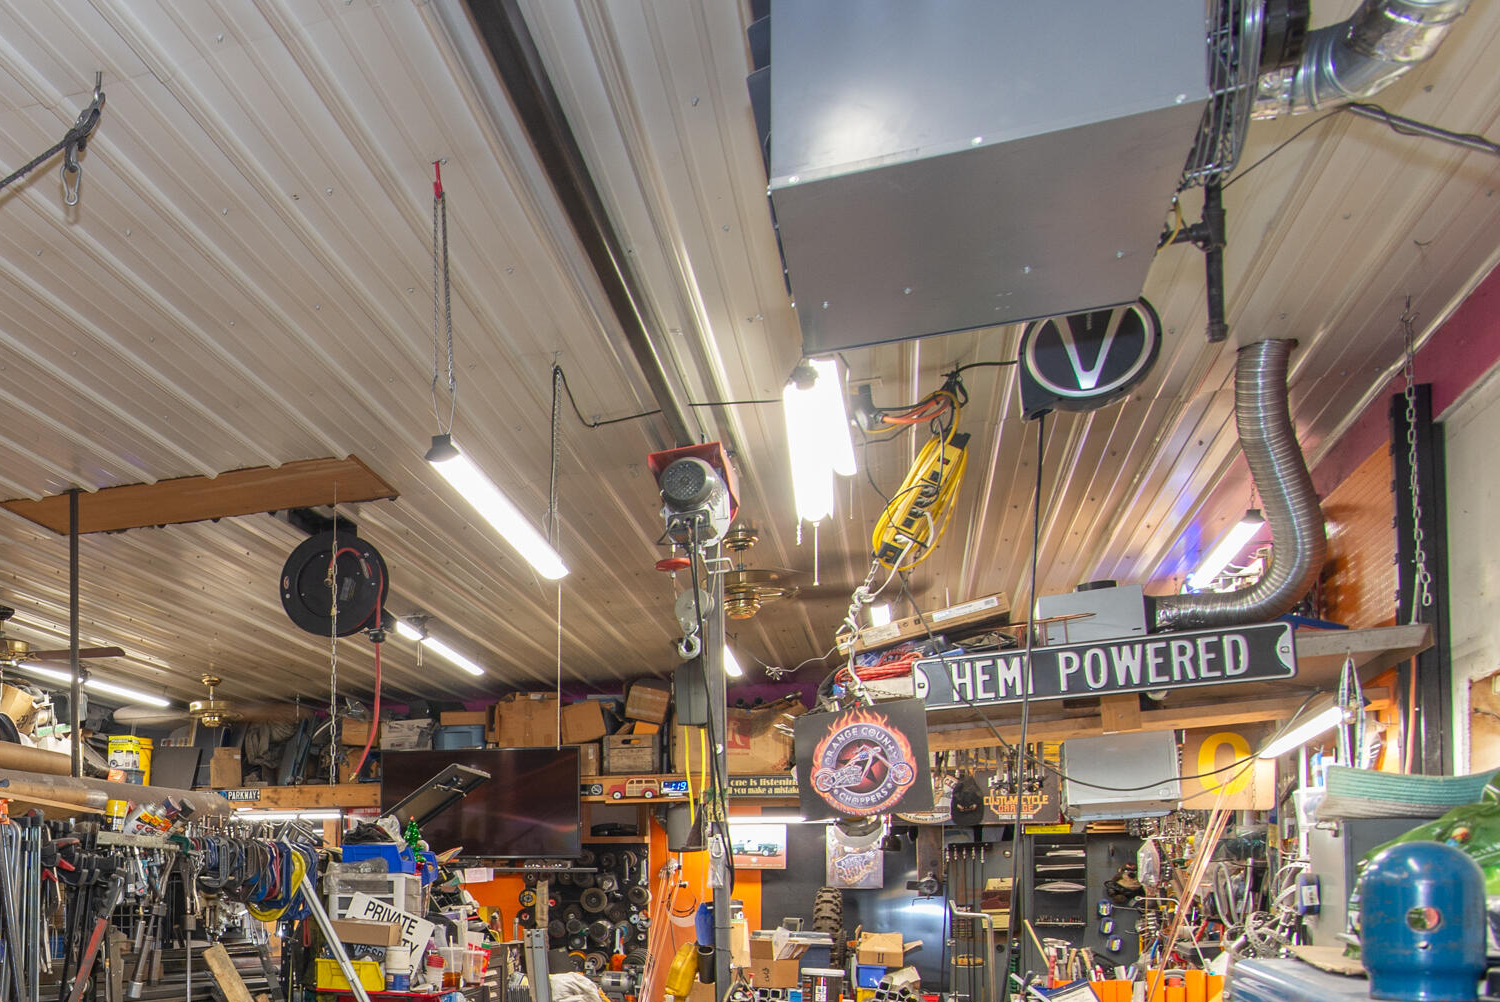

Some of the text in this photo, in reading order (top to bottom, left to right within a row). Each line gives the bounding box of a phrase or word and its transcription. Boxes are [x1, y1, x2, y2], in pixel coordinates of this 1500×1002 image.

[952, 634, 1249, 702] HEMI POWERED
[825, 727, 858, 766] ORANGE
[750, 778, 757, 786] is
[760, 778, 798, 786] listenin
[228, 790, 256, 801] PARKWAY
[734, 787, 747, 795] you
[774, 786, 800, 794] mistak
[839, 788, 888, 805] CHOPPERS
[1021, 794, 1049, 805] CYCLE
[998, 804, 1033, 812] GARGE
[363, 900, 418, 935] PRIVATE
